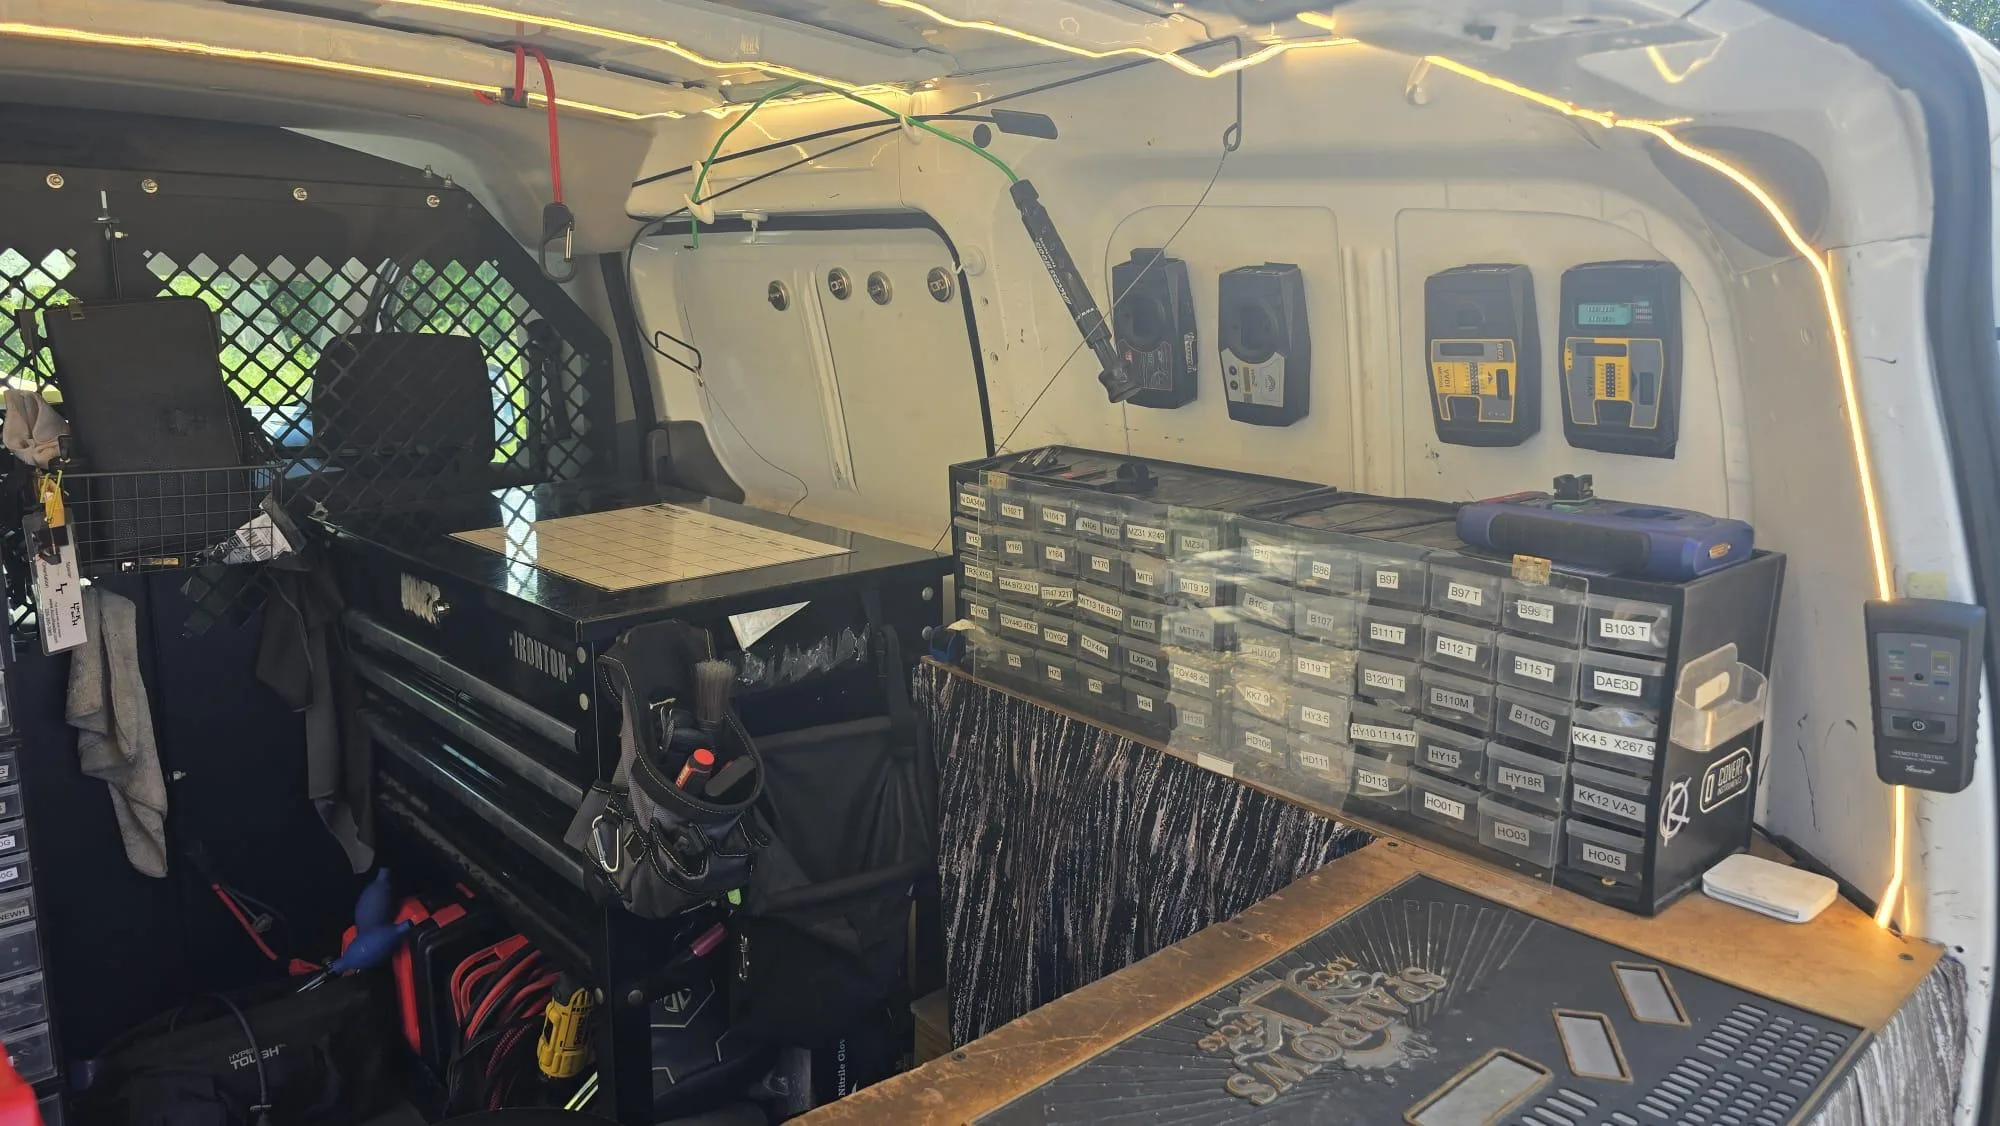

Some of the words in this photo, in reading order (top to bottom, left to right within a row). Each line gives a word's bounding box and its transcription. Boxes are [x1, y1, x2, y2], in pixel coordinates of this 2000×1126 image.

[1314, 565, 1330, 577] B86
[1379, 574, 1398, 585] B97
[1451, 587, 1471, 599] B97
[1473, 592, 1480, 602] T
[1133, 620, 1153, 630] MIT17
[1311, 615, 1333, 627] B107
[1372, 627, 1394, 639] B111
[1398, 631, 1404, 639] T
[1605, 623, 1636, 637] B103
[1639, 626, 1647, 638] T
[513, 630, 567, 684] IRONTON
[1440, 640, 1465, 656] B112
[1466, 646, 1474, 658] T
[1323, 666, 1329, 674] T
[1515, 661, 1544, 677] B115
[1366, 672, 1395, 687] B120/1
[1398, 678, 1404, 689] T
[1596, 677, 1640, 693] DAE3D
[1436, 692, 1470, 710] B110M
[1305, 710, 1322, 723] HY3
[1324, 715, 1330, 724] 5
[1514, 710, 1551, 732] B110G
[1353, 725, 1377, 738] HY10
[1379, 729, 1388, 740] 11
[1392, 732, 1402, 741] 14
[1405, 733, 1416, 744] 17
[1574, 730, 1597, 746] KK4
[1599, 735, 1608, 747] 5
[1614, 740, 1644, 754] X267
[1302, 755, 1329, 769] HD111
[1431, 749, 1458, 765] HY15
[1359, 773, 1389, 789] HD113
[1505, 771, 1543, 789] HY18R
[1579, 788, 1610, 808] KK12
[1612, 800, 1638, 816] VA2
[1455, 805, 1463, 816] T
